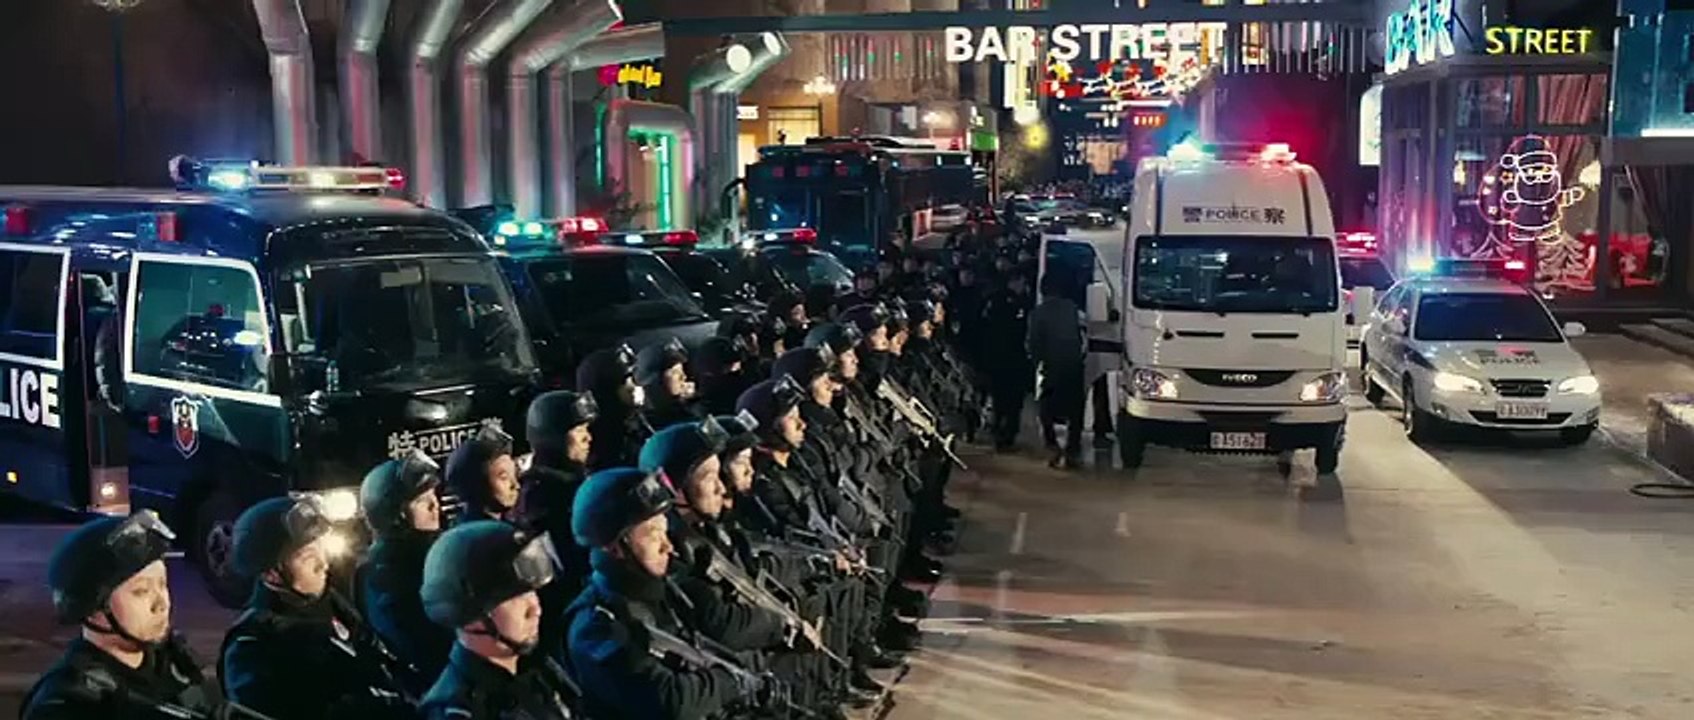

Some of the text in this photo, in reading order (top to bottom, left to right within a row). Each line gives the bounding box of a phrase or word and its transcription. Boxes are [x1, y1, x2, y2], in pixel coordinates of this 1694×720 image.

[945, 22, 1227, 63] BAR STREET
[1485, 27, 1592, 54] STREET
[388, 430, 416, 460] 特
